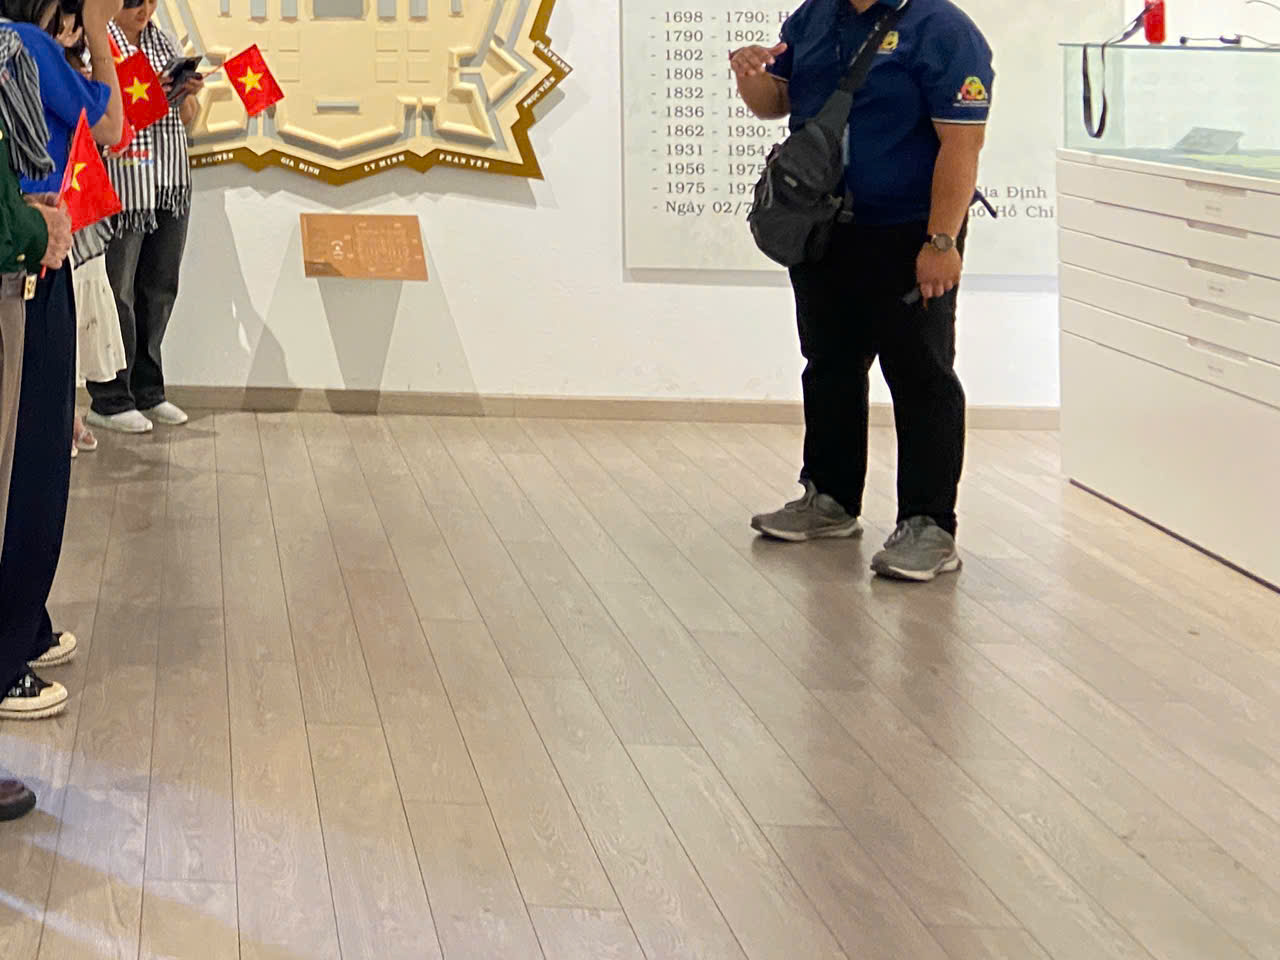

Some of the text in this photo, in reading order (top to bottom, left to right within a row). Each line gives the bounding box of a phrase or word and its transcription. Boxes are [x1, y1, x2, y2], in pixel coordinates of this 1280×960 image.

[665, 11, 703, 24] 1698
[726, 11, 770, 24] 1790:
[665, 30, 770, 43] 1790 1802:
[665, 49, 704, 61] 1802
[665, 68, 704, 80] 1808
[666, 87, 705, 99] 1832
[666, 106, 755, 119] 1836 185
[666, 125, 705, 137] 1862
[727, 125, 772, 138] 1930:
[666, 144, 704, 156] 1931
[379, 153, 405, 168] MINH
[439, 153, 466, 164] PHAN
[280, 156, 320, 176] GIA ĐỊNH
[666, 163, 705, 175] 1956
[666, 182, 706, 194] 1975
[728, 183, 755, 195] 197
[1007, 186, 1047, 200] Định
[666, 201, 706, 216] Ngày
[713, 201, 754, 216] 02/7
[1025, 205, 1055, 218] Chí
